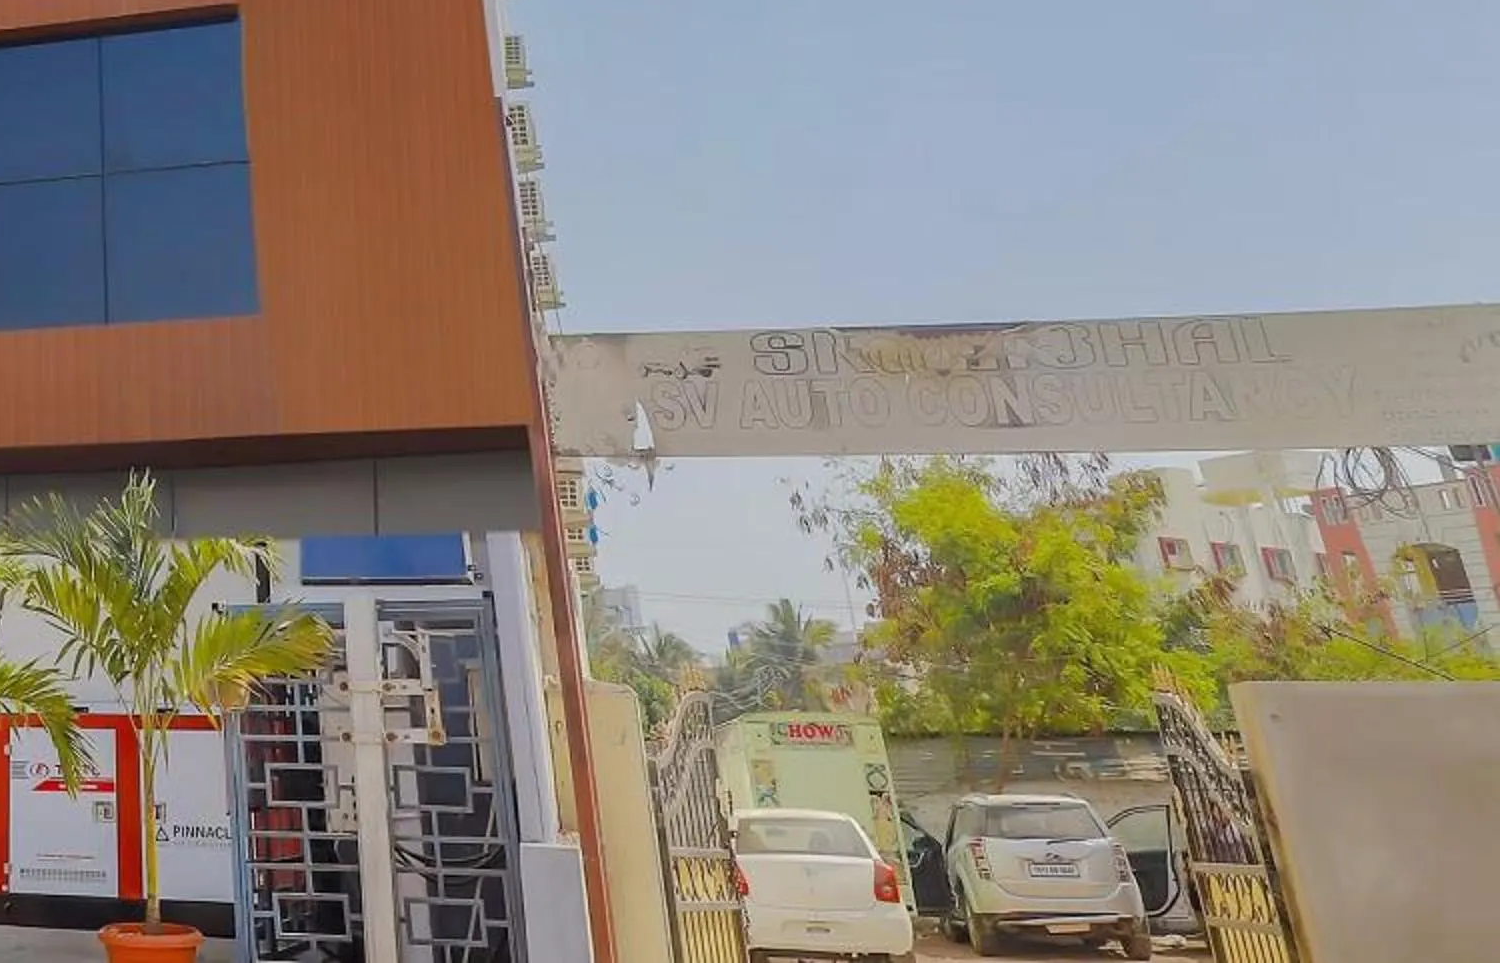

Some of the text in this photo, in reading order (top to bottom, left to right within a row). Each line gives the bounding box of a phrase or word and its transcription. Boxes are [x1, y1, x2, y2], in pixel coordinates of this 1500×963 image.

[651, 381, 718, 430] SV
[739, 377, 890, 429] AUTO
[905, 363, 1357, 427] CONSULTACY
[173, 824, 233, 840] PINNACL
